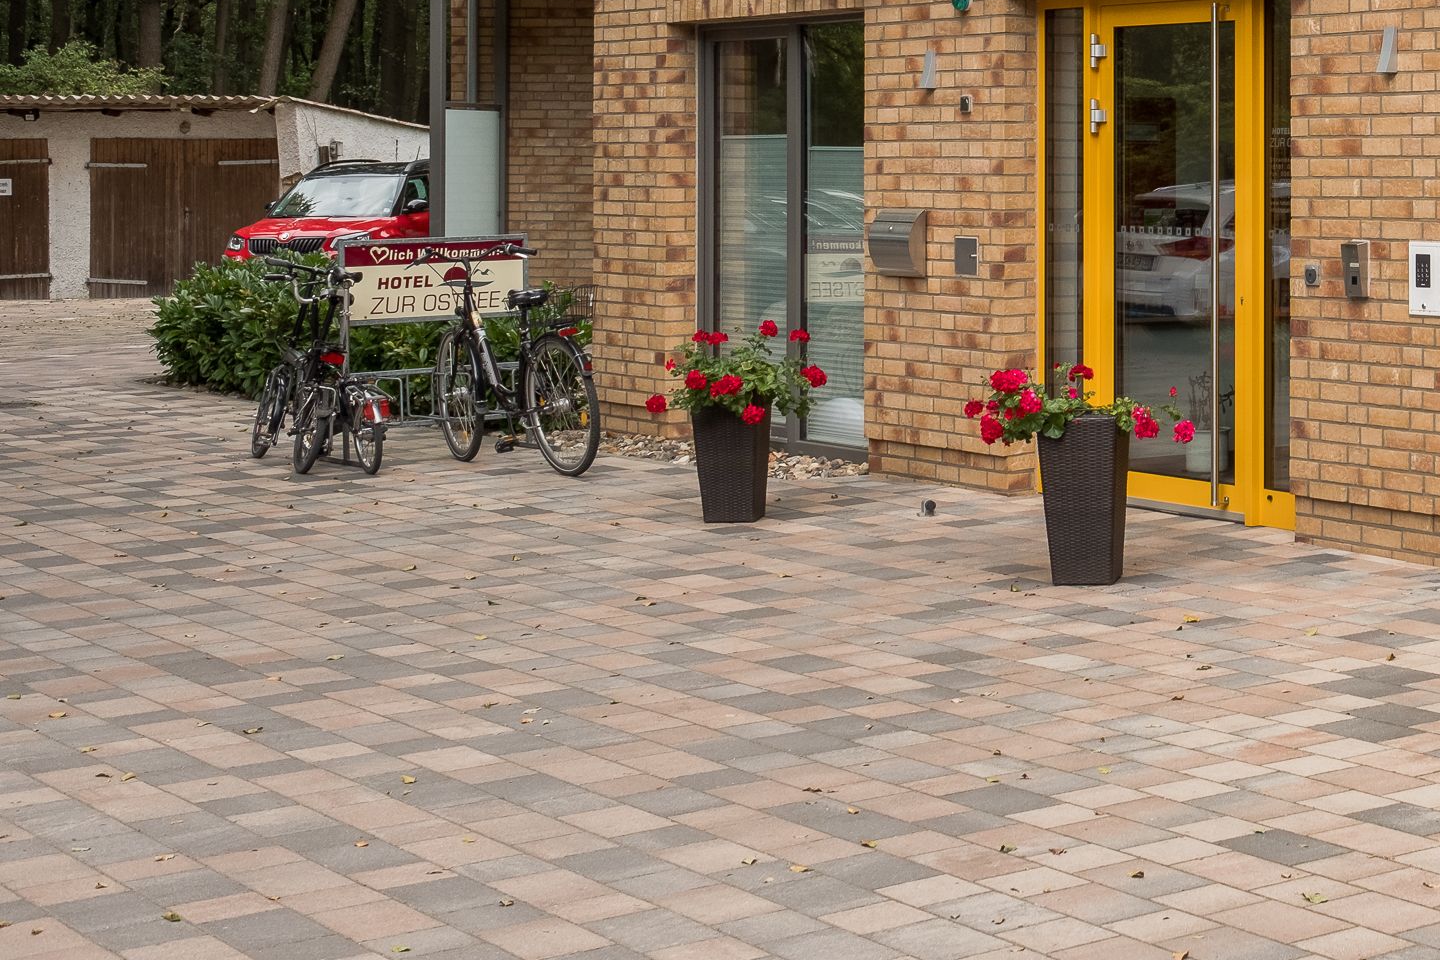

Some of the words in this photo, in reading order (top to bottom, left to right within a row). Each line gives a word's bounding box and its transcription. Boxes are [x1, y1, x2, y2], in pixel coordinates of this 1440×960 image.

[388, 248, 414, 261] lich
[377, 275, 434, 290] HOTEL
[370, 295, 415, 315] ZUR
